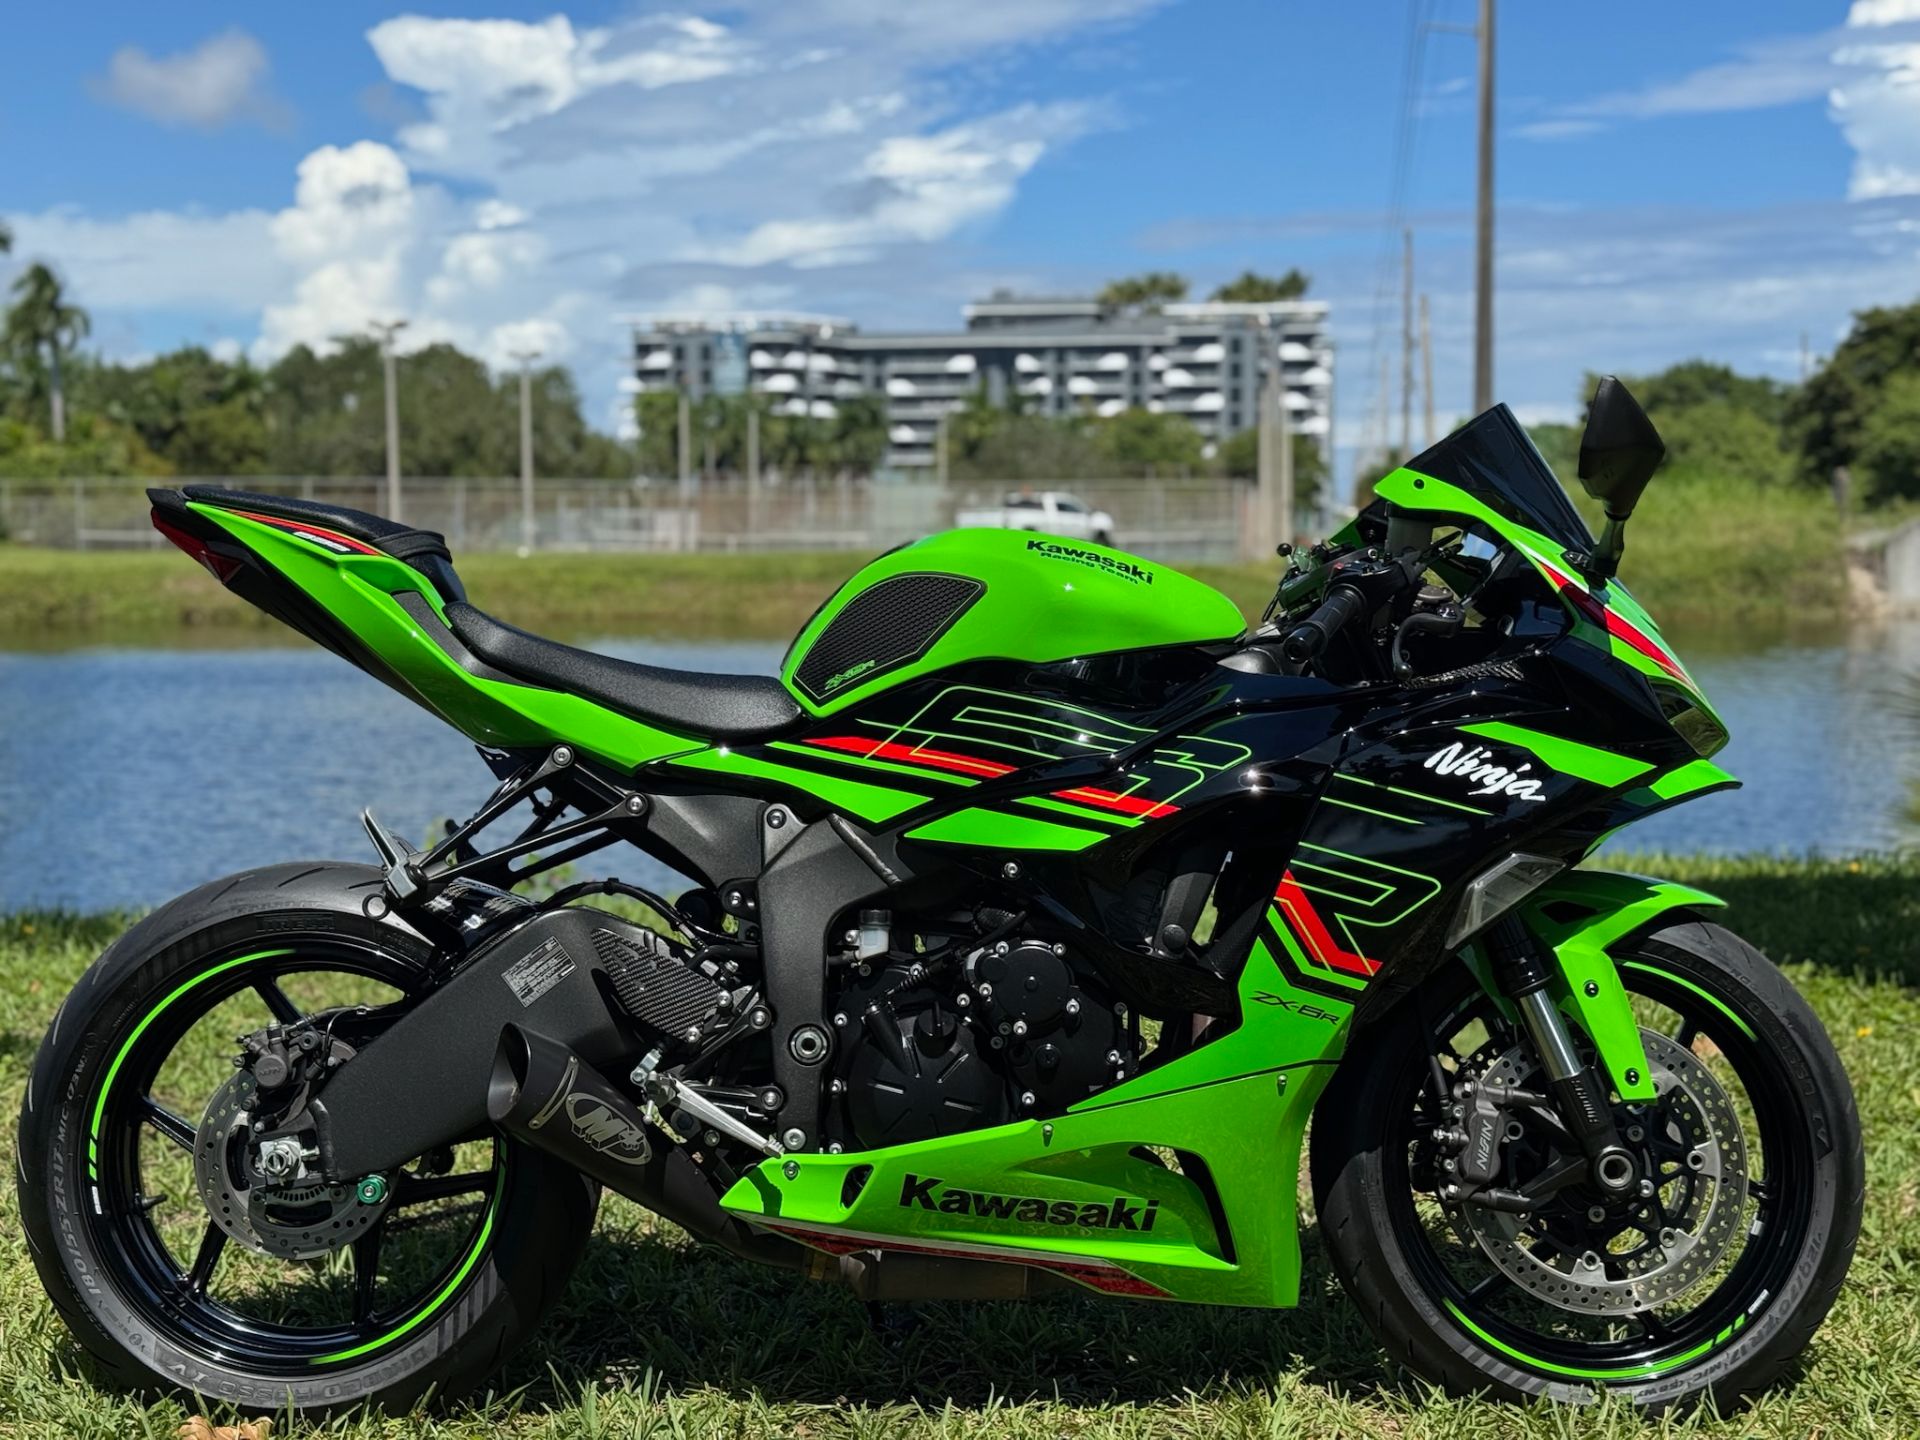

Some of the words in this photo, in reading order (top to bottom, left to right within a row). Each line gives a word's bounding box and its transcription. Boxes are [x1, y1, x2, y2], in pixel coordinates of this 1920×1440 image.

[1027, 540, 1153, 584] Kawasaki
[1041, 552, 1095, 568] Racing
[1100, 565, 1138, 584] Team
[1424, 742, 1546, 801] Ninja
[1250, 991, 1340, 1025] ZX-6R
[900, 1174, 1159, 1231] Kawasaki
